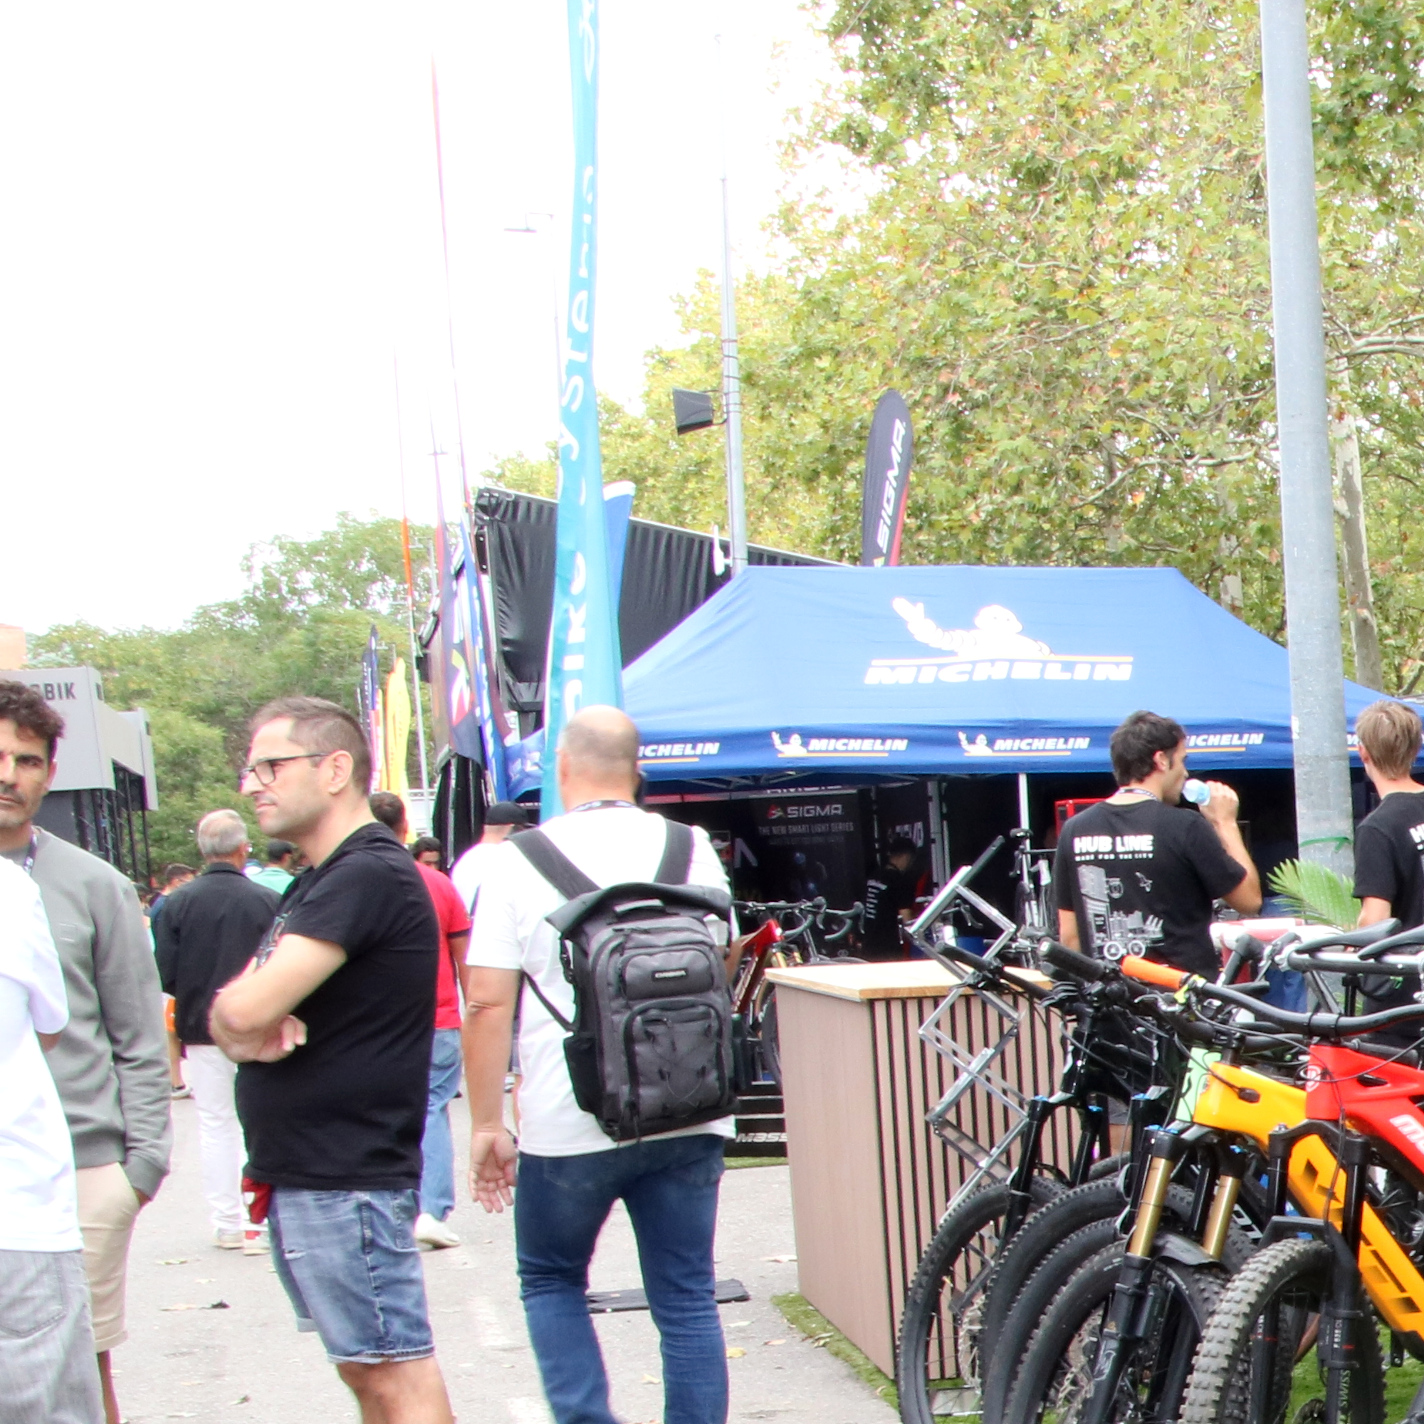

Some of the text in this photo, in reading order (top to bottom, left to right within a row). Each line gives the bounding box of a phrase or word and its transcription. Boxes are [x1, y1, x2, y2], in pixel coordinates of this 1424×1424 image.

[877, 418, 905, 554] SIGMA
[864, 661, 1133, 684] MICHELIN
[30, 682, 76, 701] BIK
[638, 742, 720, 758] ICHELIN
[808, 738, 908, 751] MICHELIN
[993, 737, 1089, 752] MICHELIN
[786, 803, 843, 818] SIGMA
[1073, 835, 1154, 853] HUB LINE
[1339, 1370, 1350, 1408] SWISS
